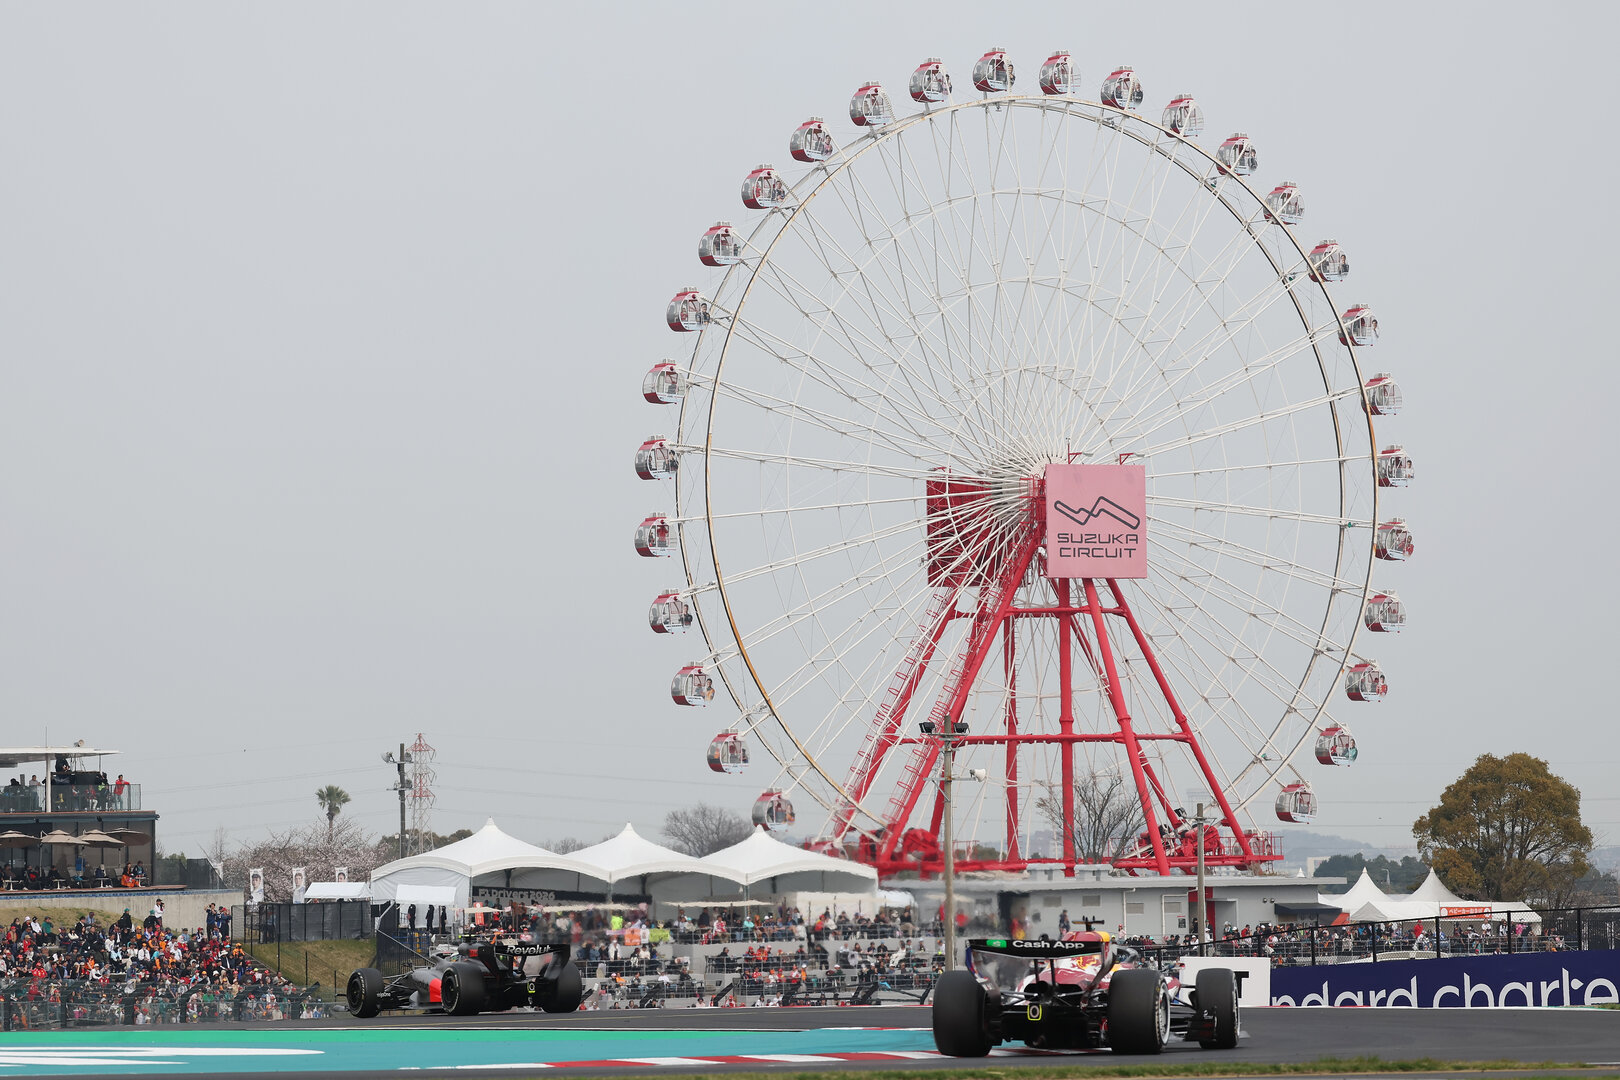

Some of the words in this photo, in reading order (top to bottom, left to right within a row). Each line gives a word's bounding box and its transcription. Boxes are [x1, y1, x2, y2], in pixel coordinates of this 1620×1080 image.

[1058, 533, 1138, 544] SUZUKA
[1059, 547, 1137, 558] CIRCUIT
[506, 944, 551, 955] Revolut
[1012, 940, 1050, 948] Cash
[1053, 940, 1085, 949] App
